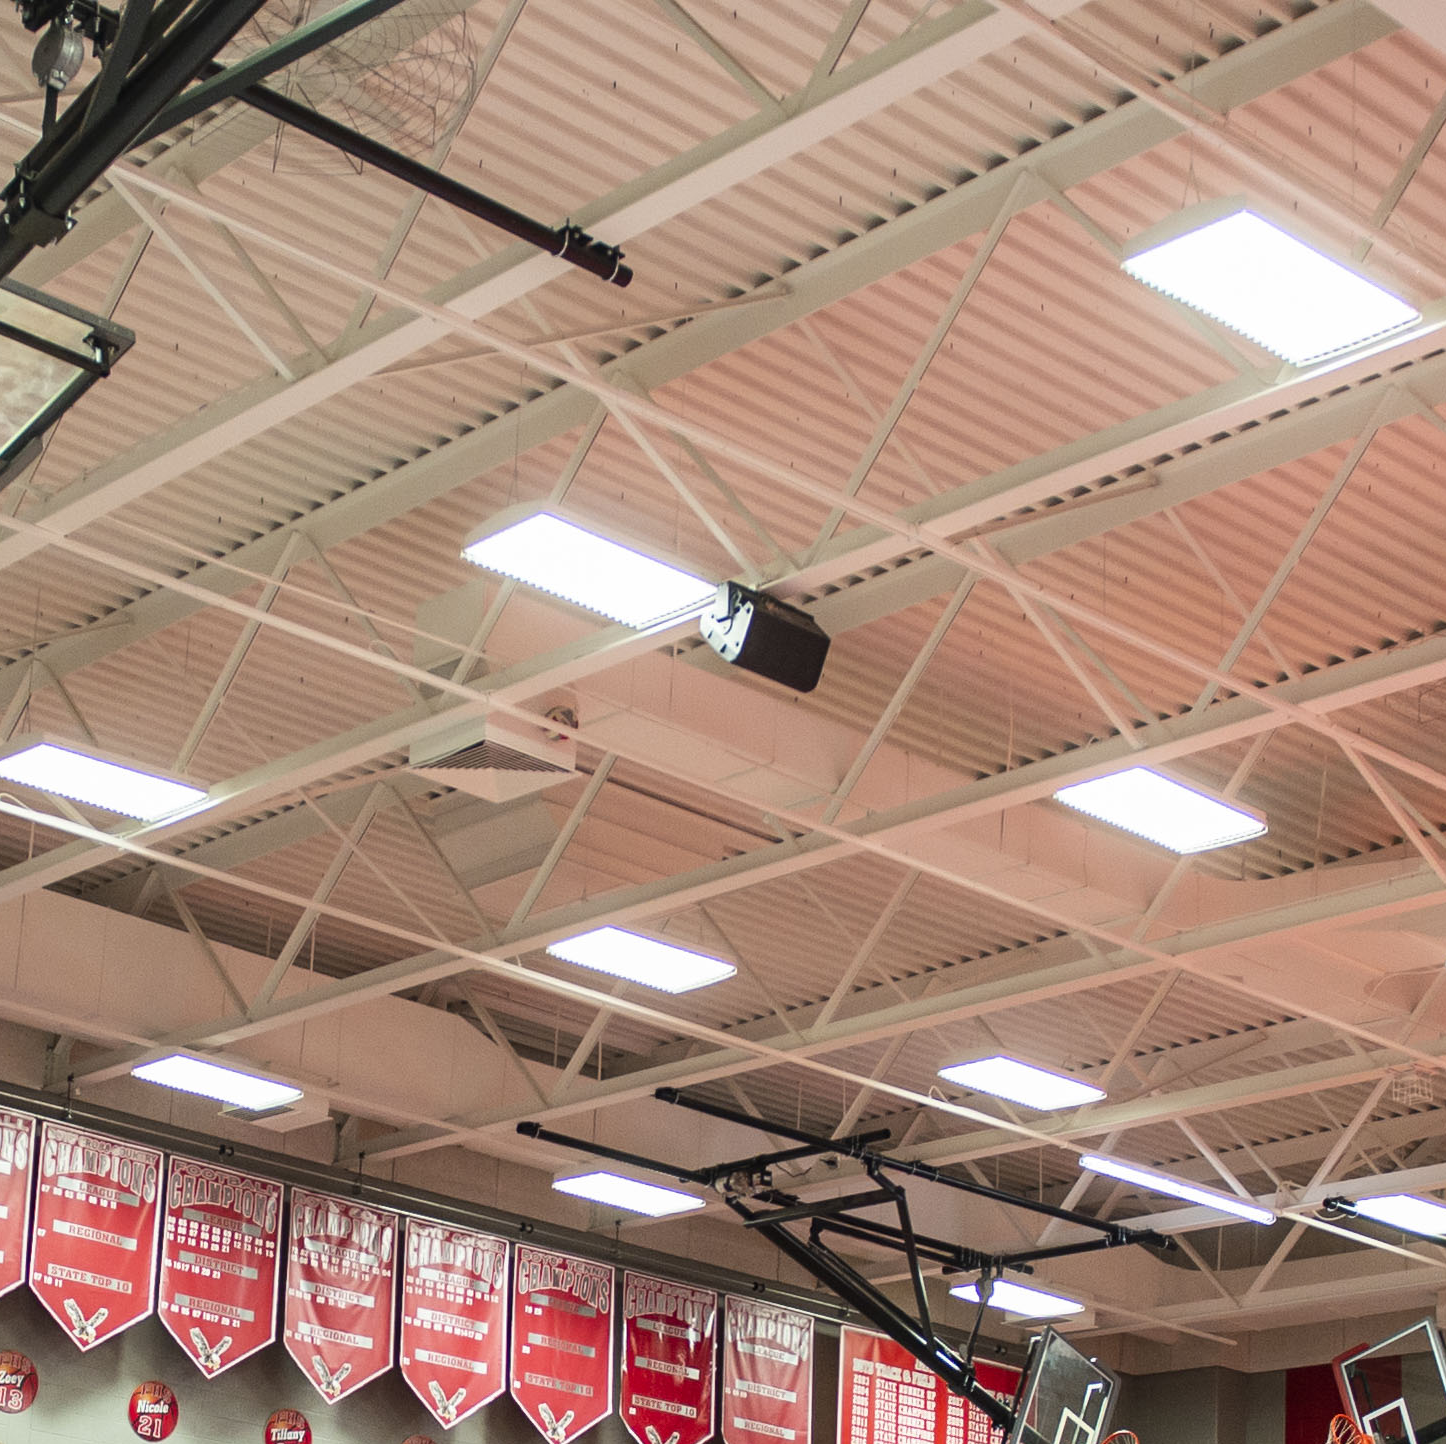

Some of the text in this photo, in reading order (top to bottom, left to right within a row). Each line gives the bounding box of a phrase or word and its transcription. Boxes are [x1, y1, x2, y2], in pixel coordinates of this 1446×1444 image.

[44, 1139, 156, 1203] CHAMPIONS
[174, 1161, 278, 1199] FOOTBALL
[80, 1183, 121, 1200] LEAGUE
[170, 1173, 277, 1234] CHAMPIONS
[204, 1214, 243, 1230] LEAGUE
[69, 1225, 123, 1245] REGIONAL
[294, 1204, 393, 1262] CHAMPIONS
[322, 1244, 360, 1260] LEAGUE
[195, 1254, 244, 1274] DISTRICT
[408, 1234, 504, 1289] CHAMPIONS
[567, 1260, 610, 1279] TENNIS
[51, 1266, 87, 1281] STATE
[91, 1275, 112, 1289] TOP
[438, 1272, 474, 1289] LEAGUE
[518, 1259, 609, 1314] CHAMPIONS
[315, 1284, 362, 1303] DISTRICT
[189, 1297, 240, 1317] REGIONAL
[627, 1286, 714, 1338] CHAMPIONS
[431, 1313, 475, 1329] DISTRICT
[310, 1327, 359, 1345] REGIONAL
[728, 1311, 809, 1361] CHAMPIONS
[541, 1337, 583, 1354] REGIONAL
[428, 1354, 474, 1371] REGIONAL
[647, 1360, 689, 1376] REGIONAL
[748, 1384, 786, 1399] DISTRICT
[137, 1400, 169, 1413] Nicole
[635, 1396, 663, 1409] STATE
[666, 1402, 682, 1413] TOP
[138, 1415, 162, 1438] 21
[745, 1421, 784, 1437] REGIONAL
[874, 1420, 896, 1433] STATE
[874, 1431, 896, 1443] STATE
